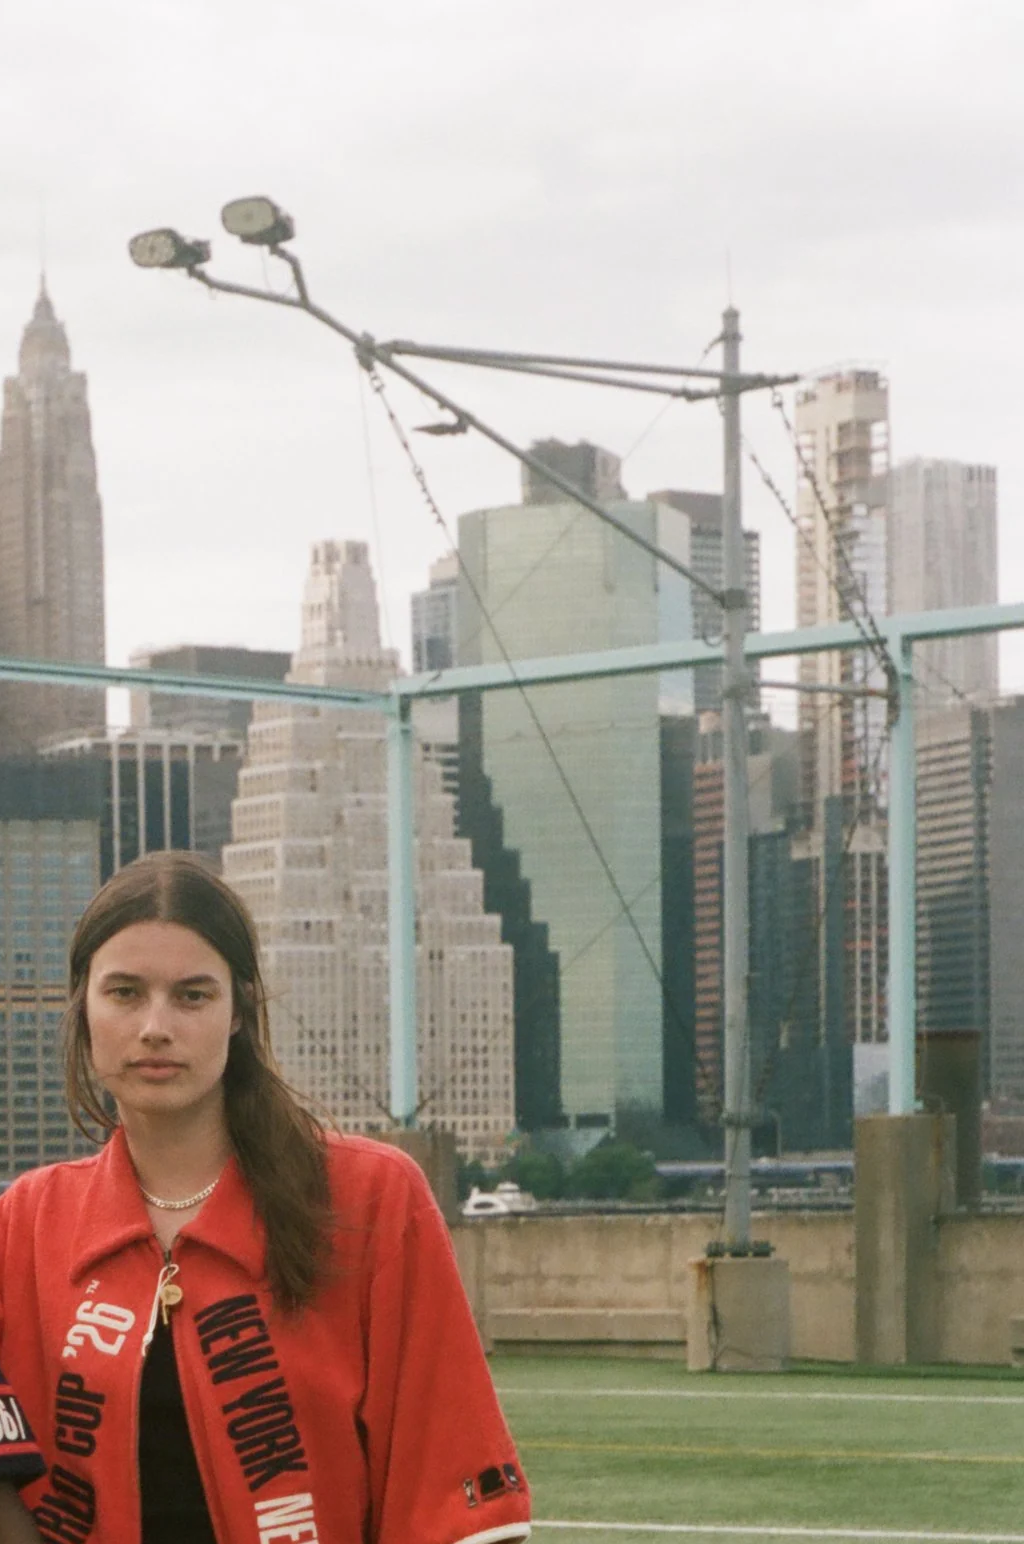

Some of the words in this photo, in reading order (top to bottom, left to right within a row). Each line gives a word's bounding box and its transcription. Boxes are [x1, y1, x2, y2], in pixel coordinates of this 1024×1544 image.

[193, 1293, 279, 1386] NEW
[55, 1371, 105, 1457] CUP
[222, 1376, 308, 1492] YORK
